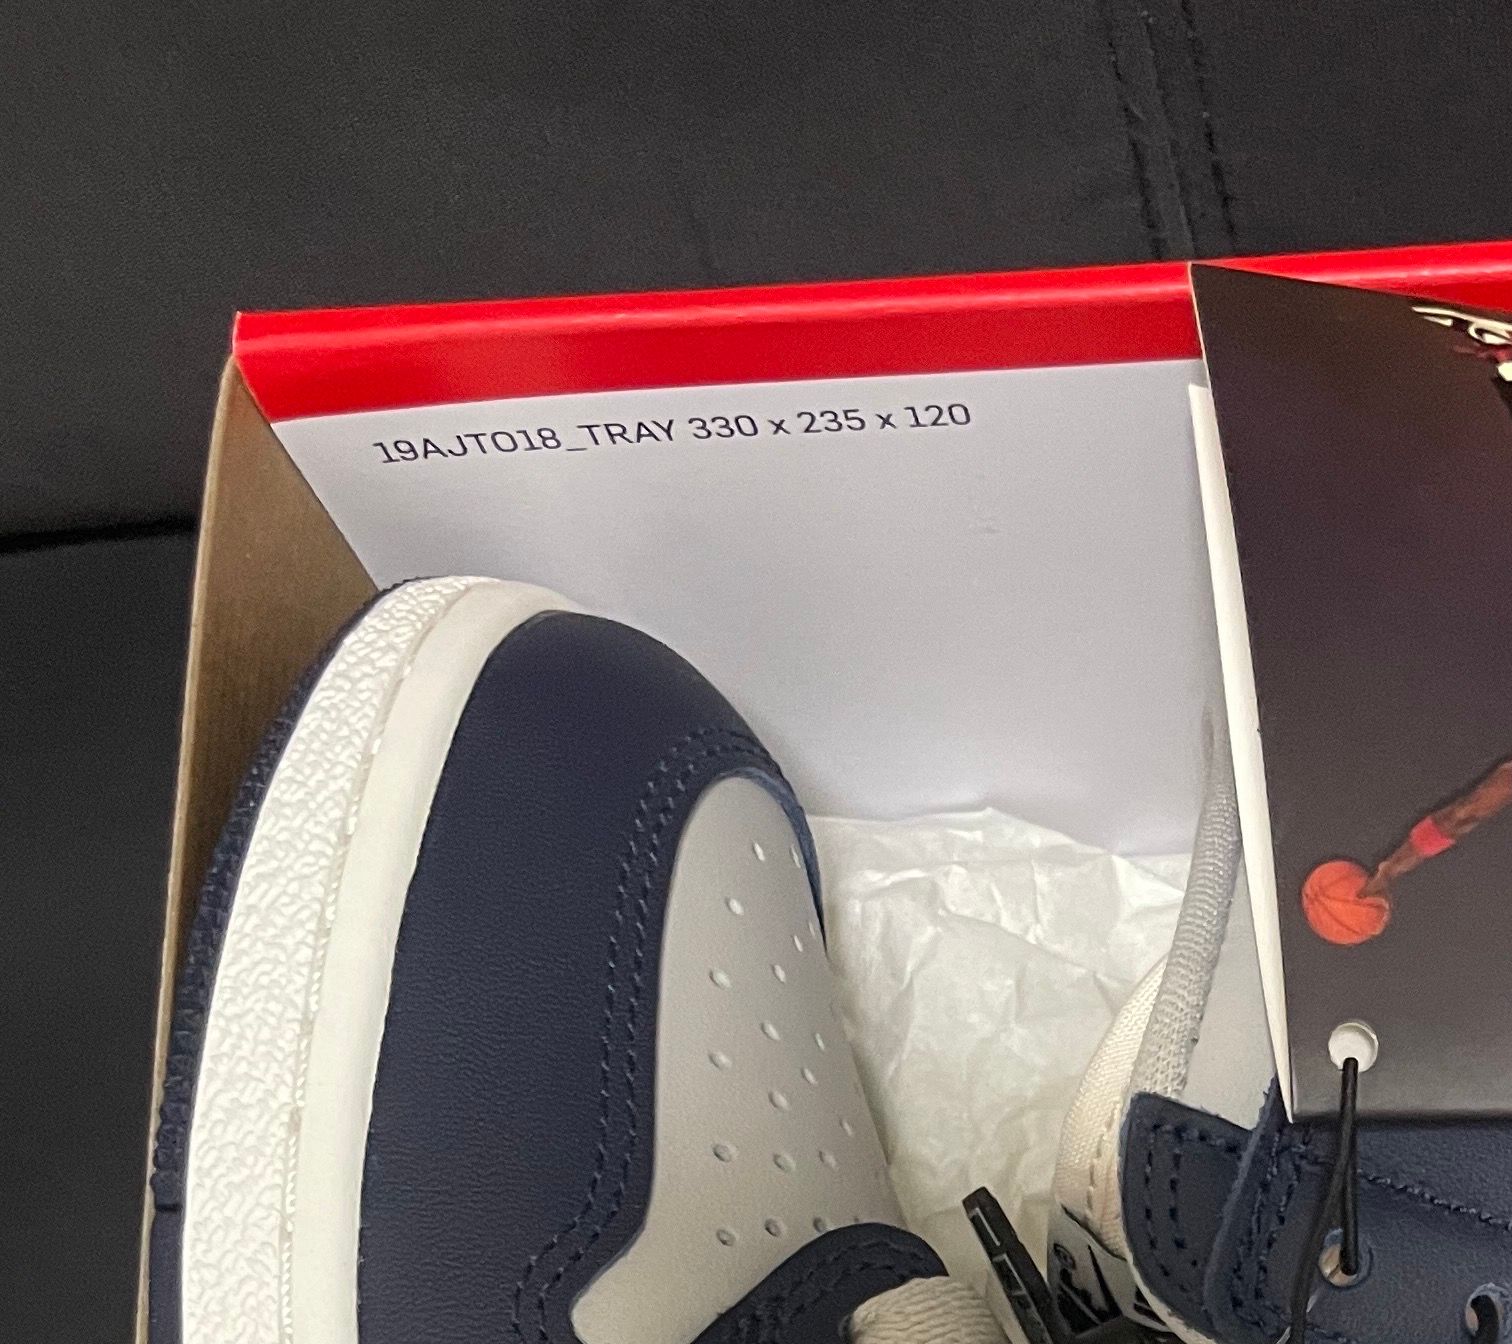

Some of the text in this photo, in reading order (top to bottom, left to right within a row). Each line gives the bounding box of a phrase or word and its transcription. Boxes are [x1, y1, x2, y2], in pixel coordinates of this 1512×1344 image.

[688, 414, 759, 440] 330
[797, 408, 866, 433] 235
[904, 403, 972, 428] 120
